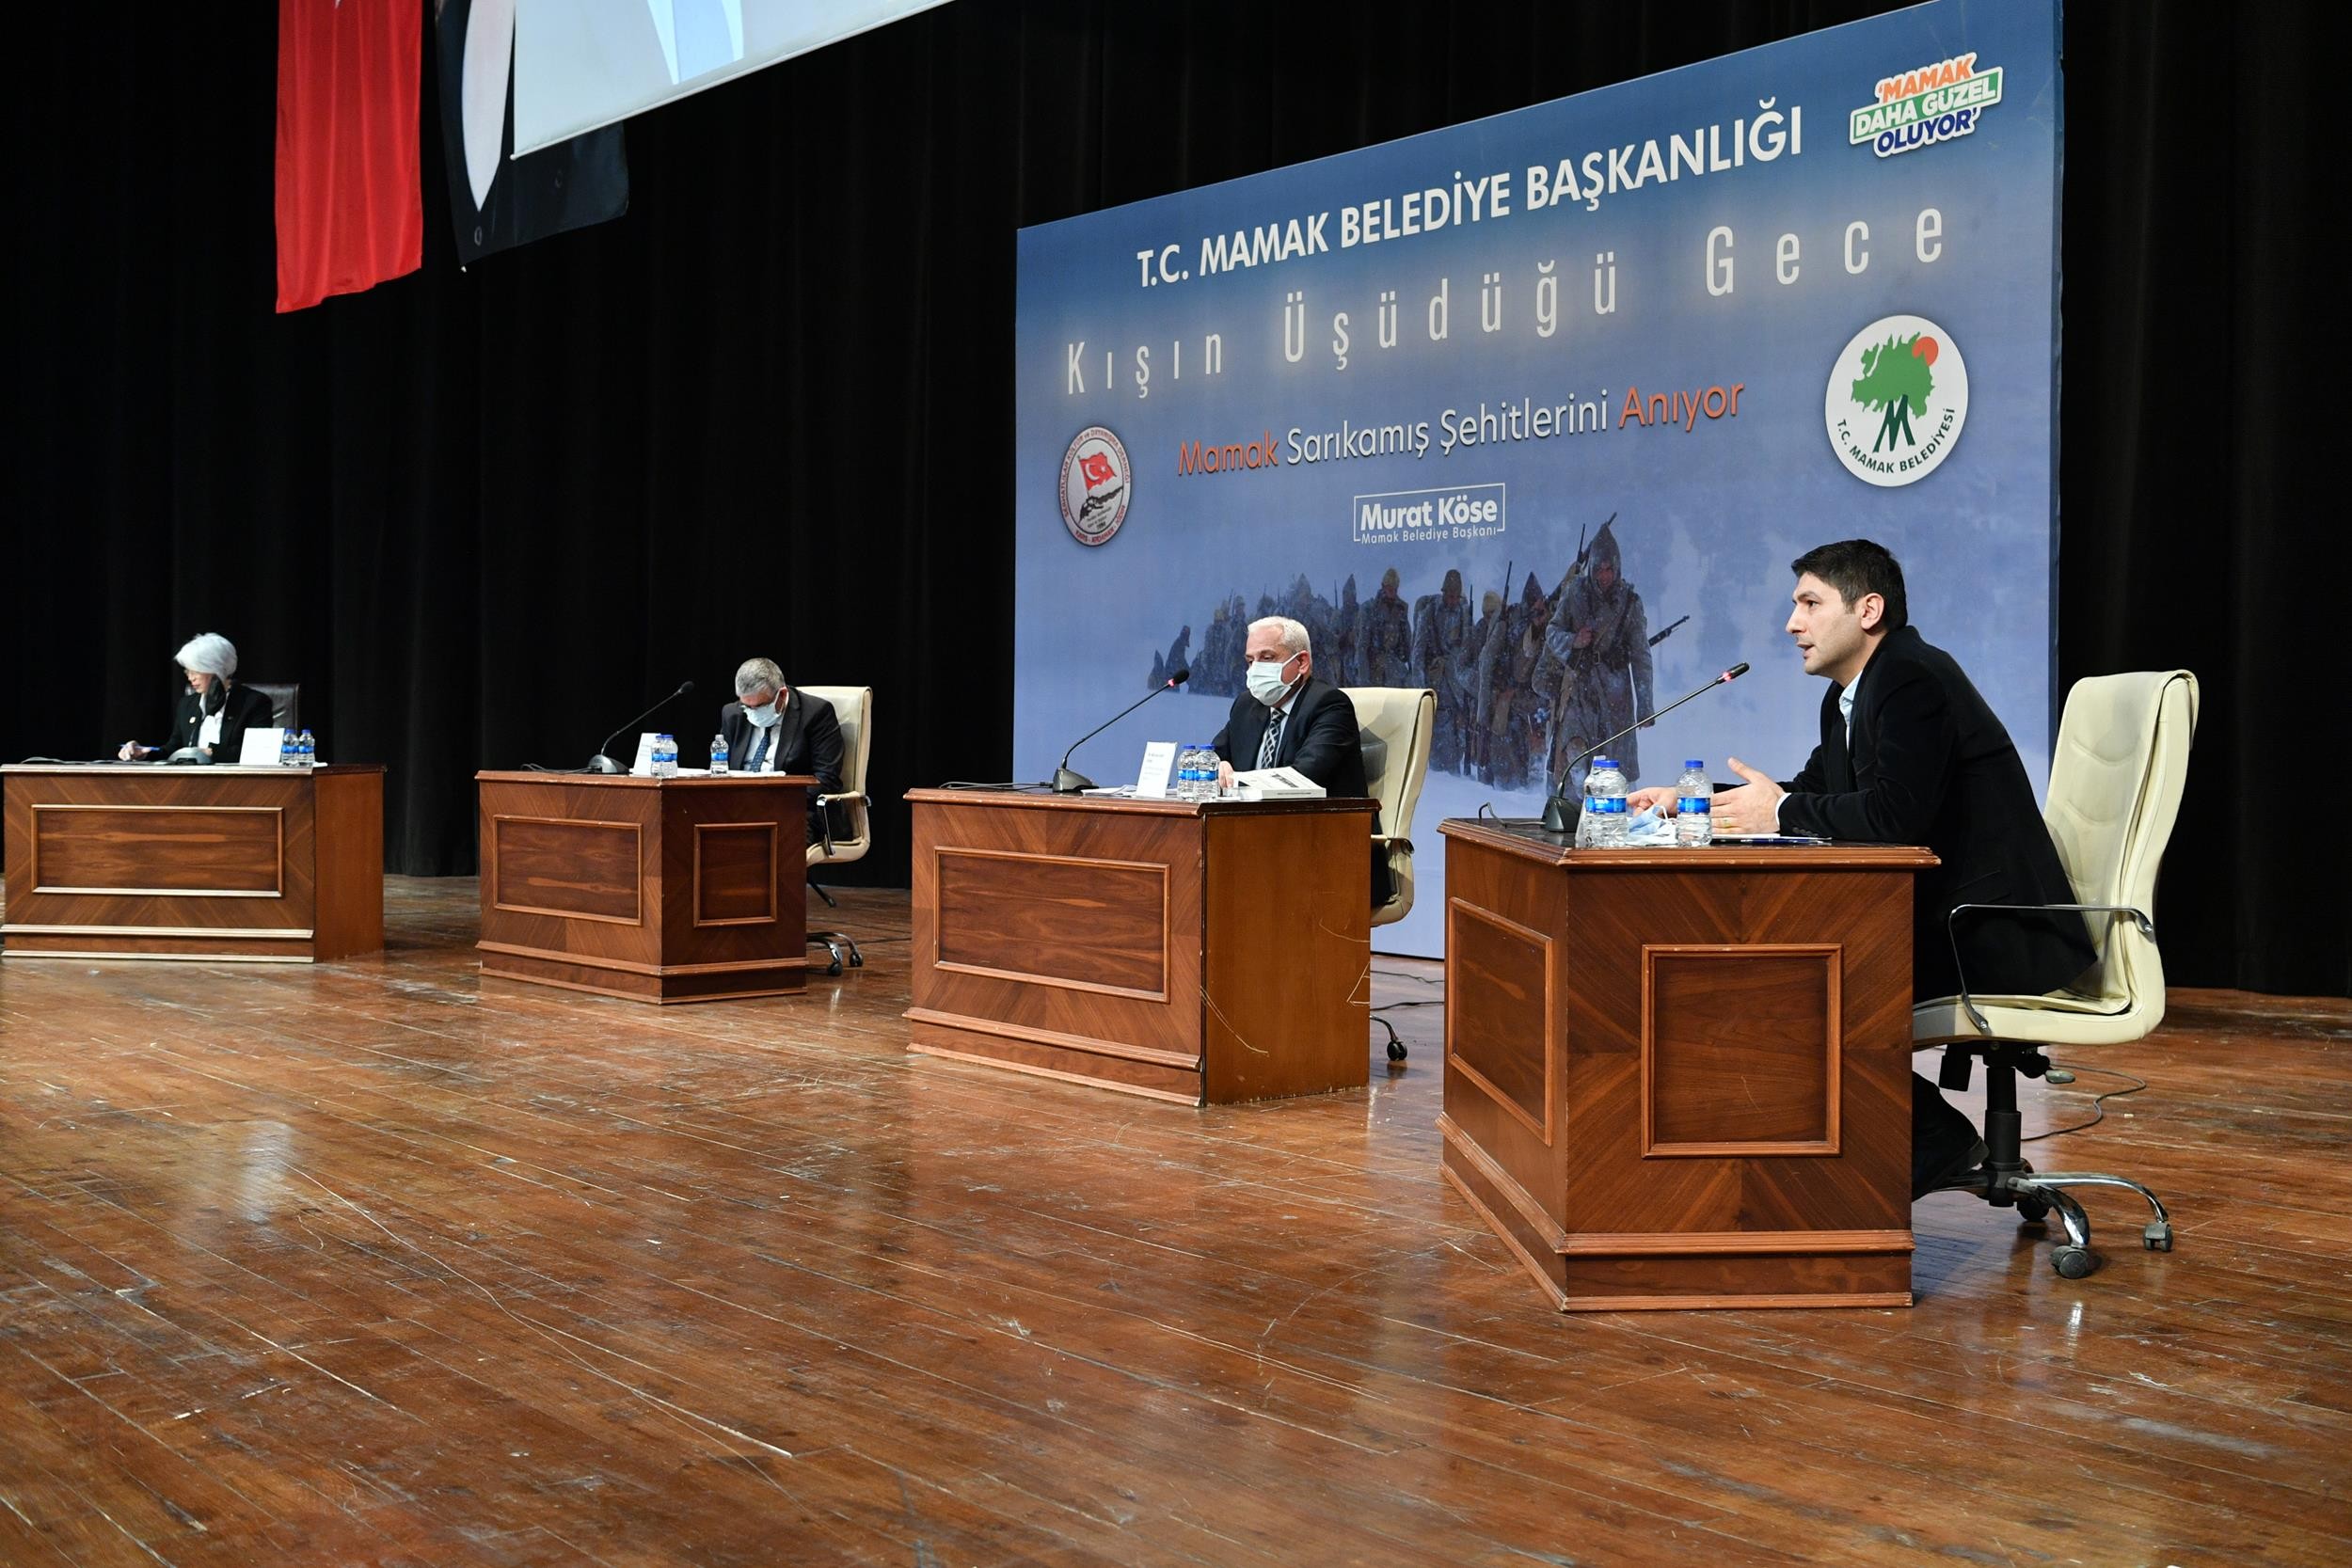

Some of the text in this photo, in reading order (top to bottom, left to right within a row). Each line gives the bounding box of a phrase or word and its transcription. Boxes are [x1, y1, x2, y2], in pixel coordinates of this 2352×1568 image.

[1855, 99, 1918, 137] DAHA
[1137, 96, 1802, 288] T.C. MAMAK BELEDİYE BAŞKANLIĞI
[1068, 207, 1942, 399] Kışın Üşüdüğü Gece
[1178, 383, 1744, 476] Mamak Sarıkamış Şehitlerini Anıyor
[1836, 407, 1956, 474] T.C. MAMAK BELEDİYESİ
[1360, 495, 1498, 531] Murat Köse
[1361, 525, 1497, 545] Mamak Belediye Başkanı
